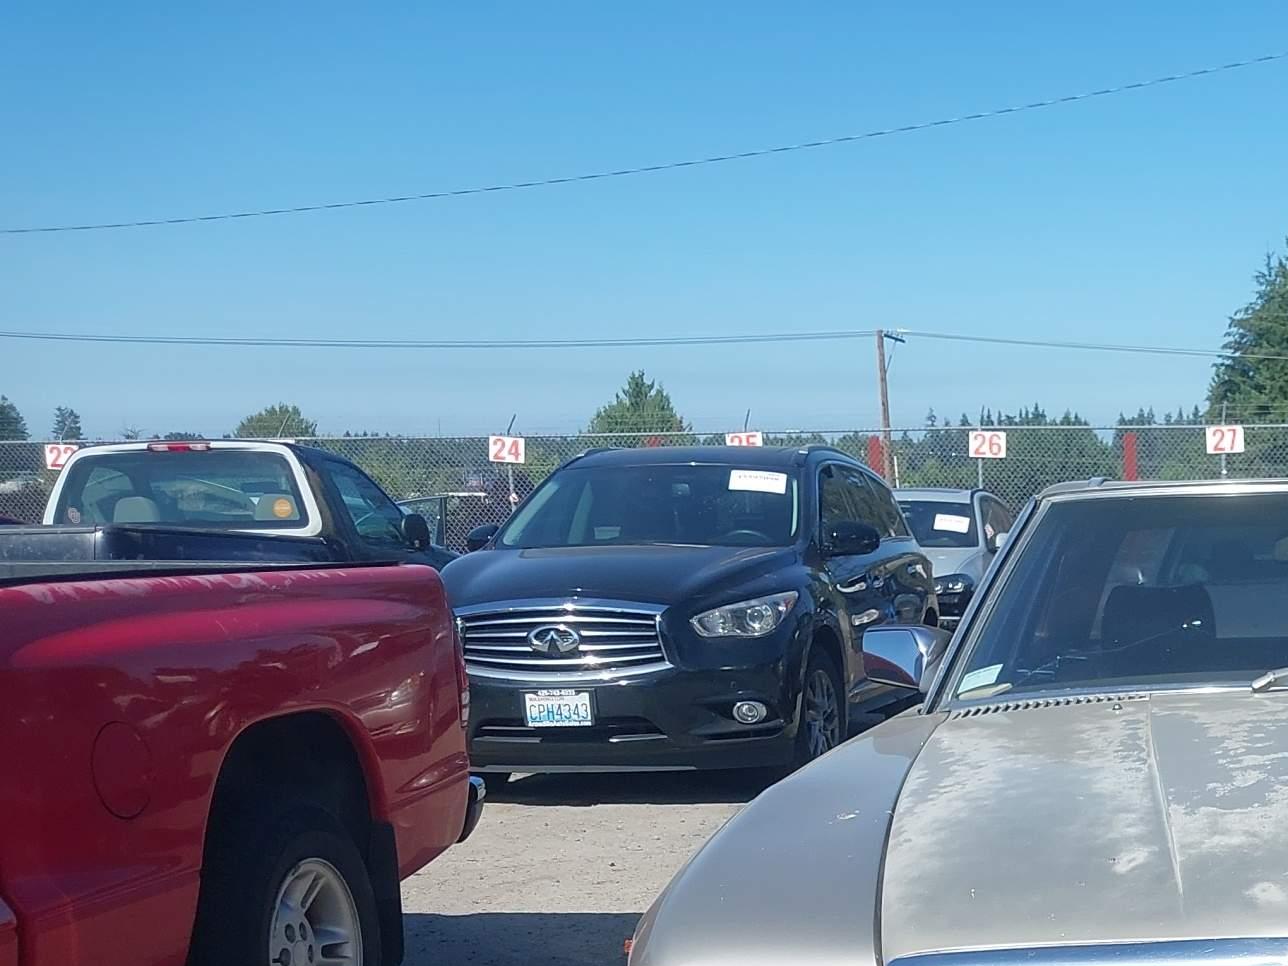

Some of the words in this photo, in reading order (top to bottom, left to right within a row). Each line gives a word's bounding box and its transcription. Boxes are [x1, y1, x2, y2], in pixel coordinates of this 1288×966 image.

[492, 438, 521, 461] 24
[974, 433, 1002, 456] 26
[1212, 428, 1236, 452] 27
[529, 703, 589, 721] CPH4343
